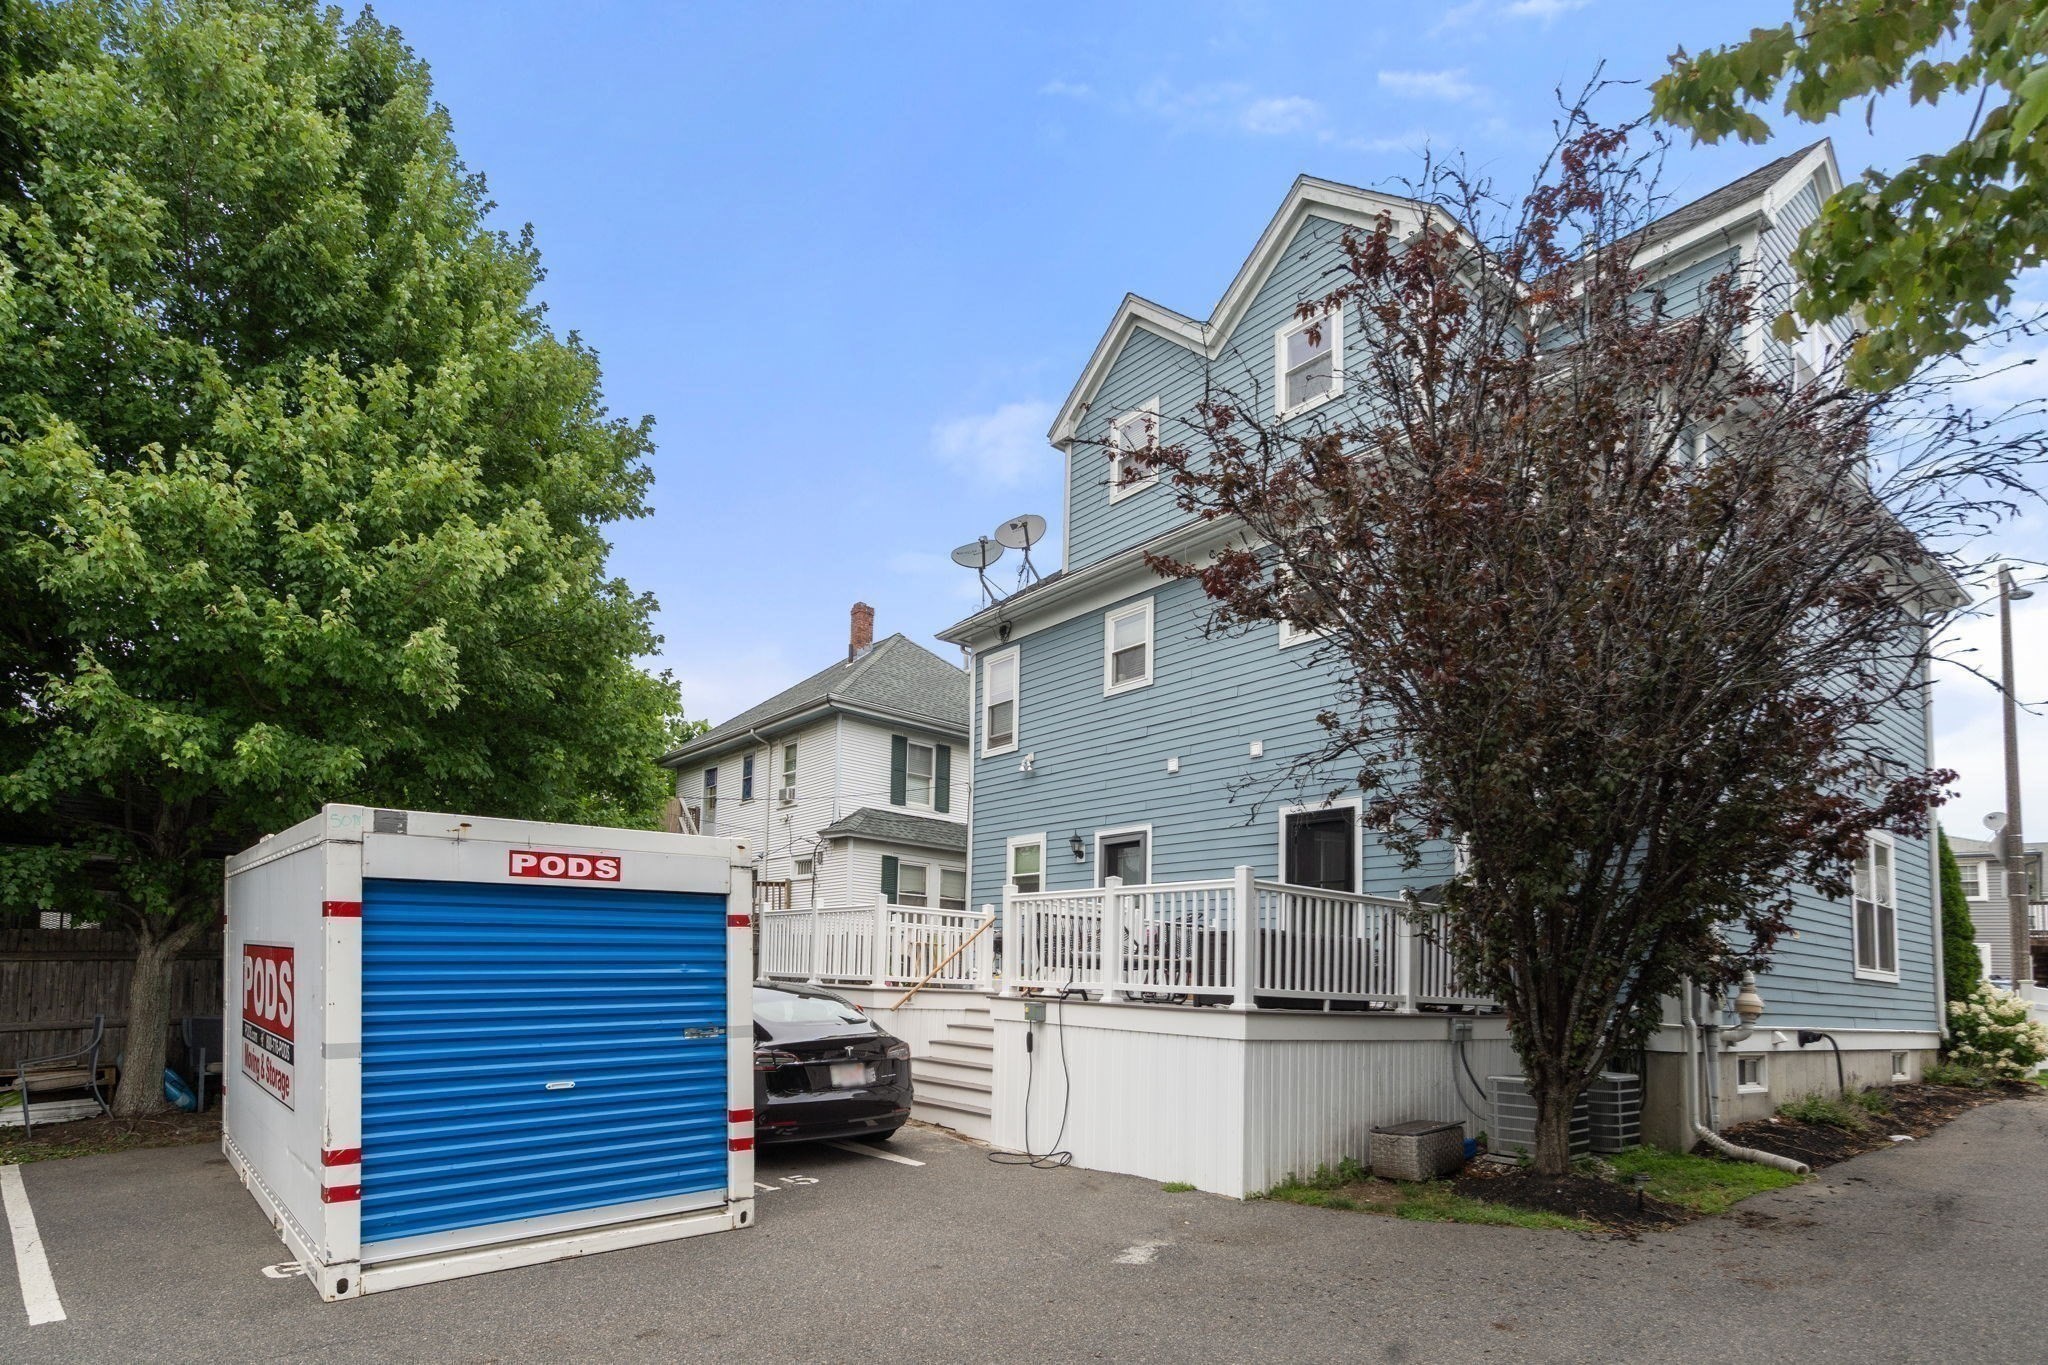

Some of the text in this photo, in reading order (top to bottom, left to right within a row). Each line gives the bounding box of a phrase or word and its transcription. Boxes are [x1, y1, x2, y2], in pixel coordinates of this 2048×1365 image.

[511, 853, 618, 879] PODS
[243, 955, 293, 1028] PODS
[244, 1042, 290, 1101] Moving & Storage
